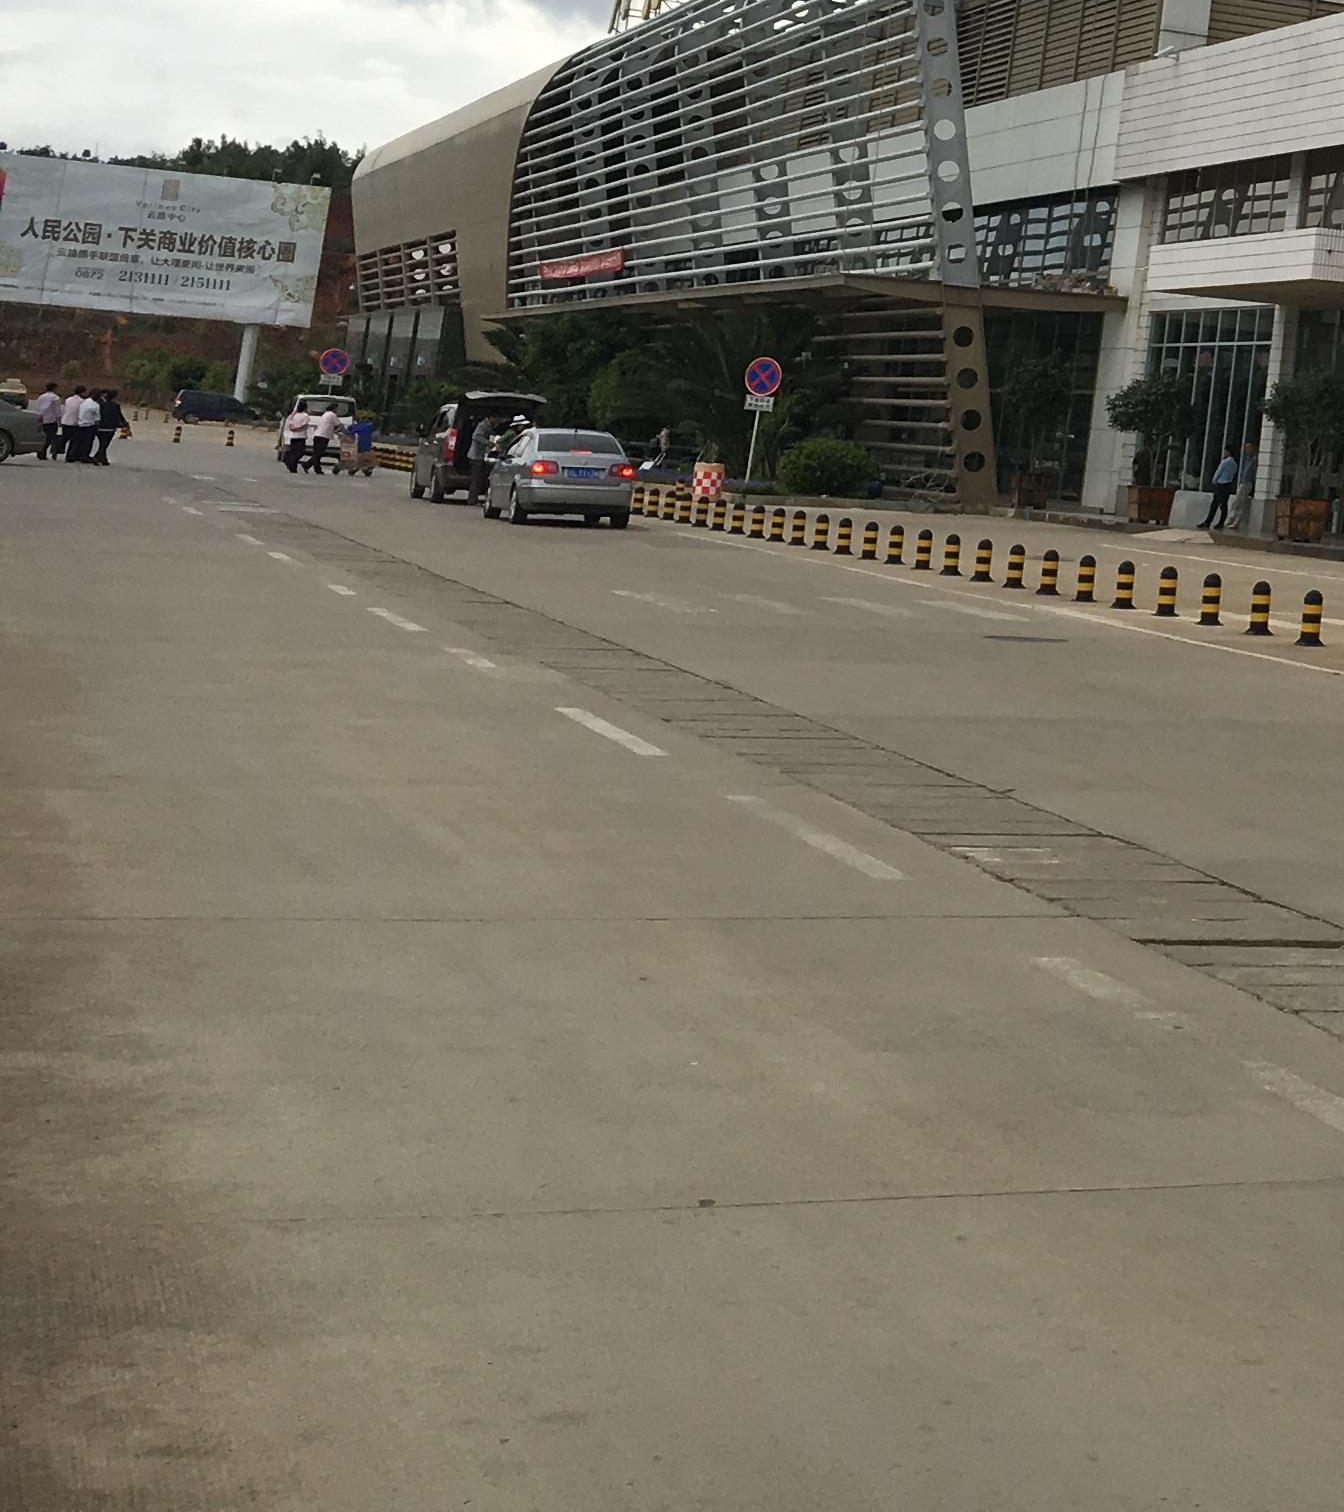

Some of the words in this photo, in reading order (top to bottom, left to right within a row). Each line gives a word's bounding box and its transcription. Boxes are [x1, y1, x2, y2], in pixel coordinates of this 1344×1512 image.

[74, 269, 104, 281] 0872
[117, 269, 170, 287] 2131111
[180, 275, 232, 292] 2151111
